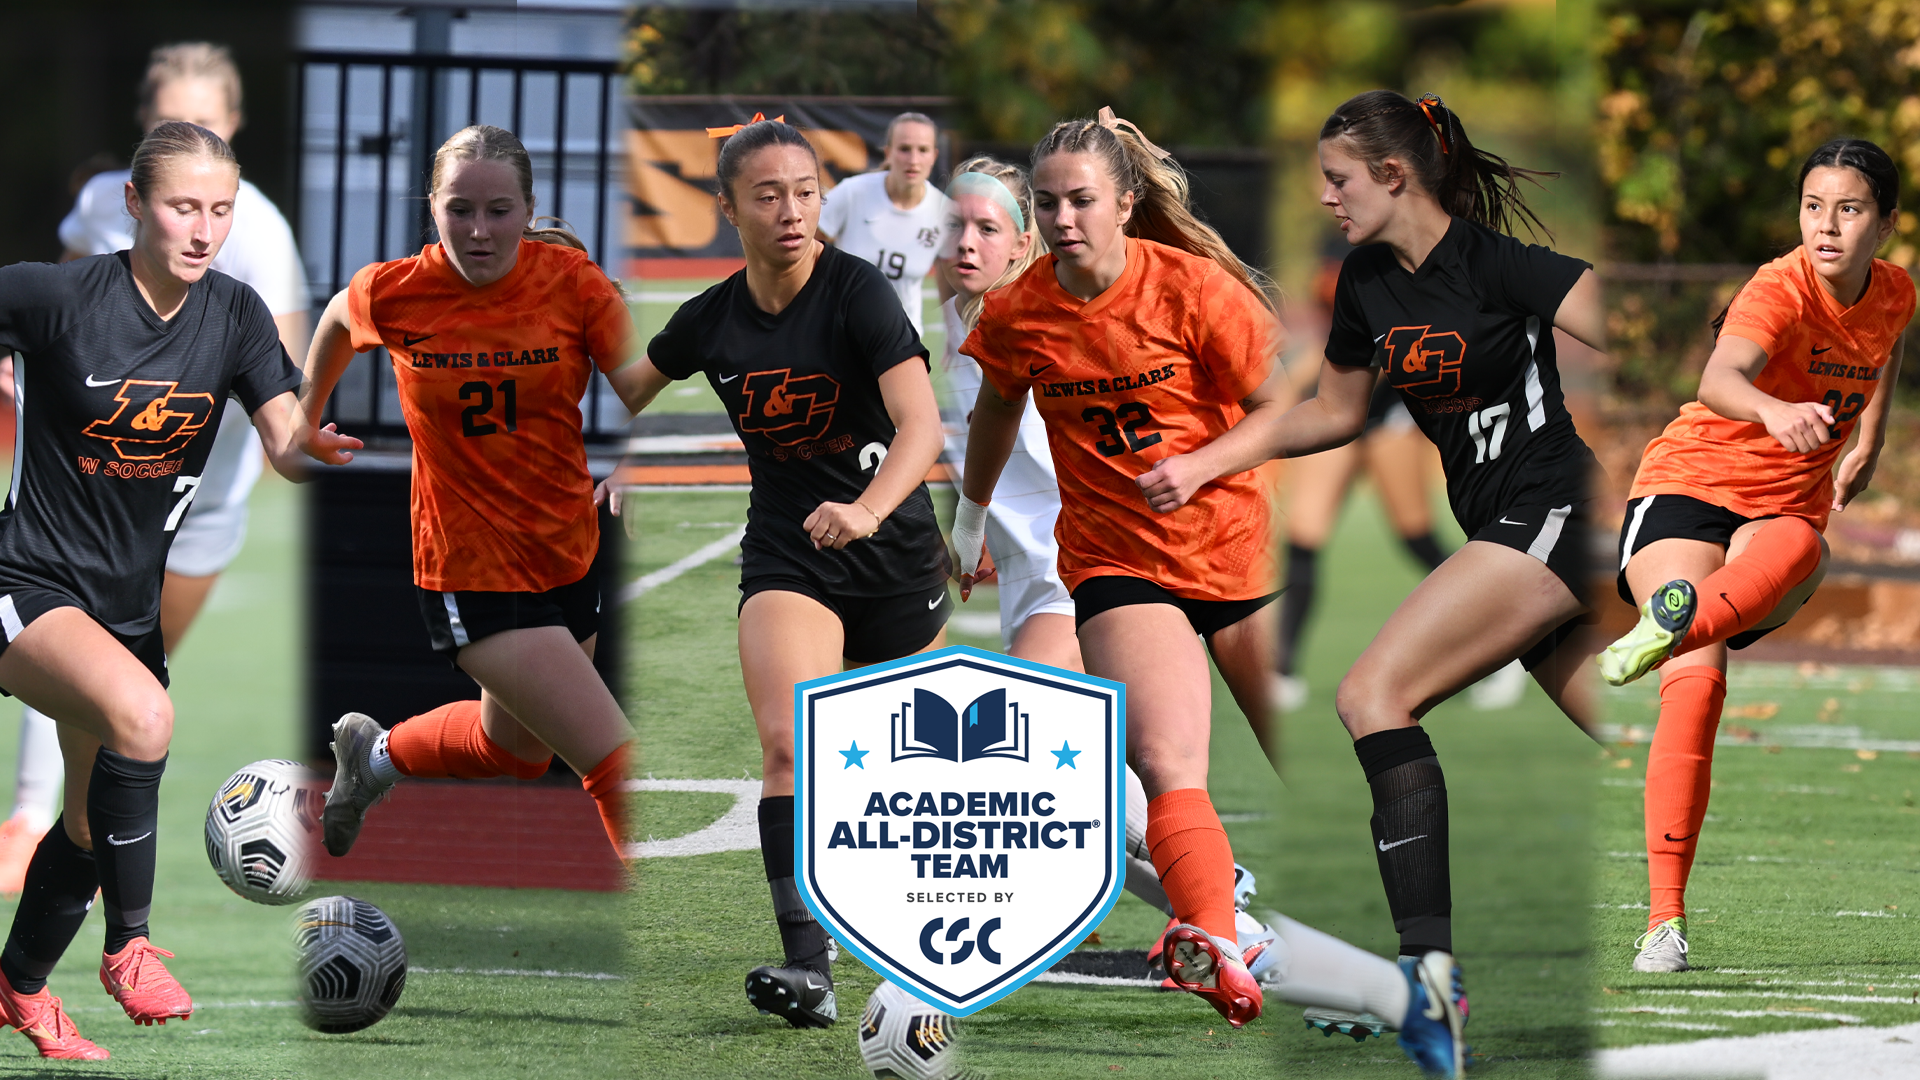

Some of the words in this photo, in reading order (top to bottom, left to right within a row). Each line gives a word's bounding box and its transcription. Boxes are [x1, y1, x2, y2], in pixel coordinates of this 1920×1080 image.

[877, 249, 906, 280] 19
[411, 352, 473, 369] LEWIS
[477, 352, 490, 367] &
[493, 347, 559, 367] CLARK
[1808, 361, 1848, 378] LEWIS
[1846, 366, 1857, 379] &
[1041, 380, 1096, 397] LEWIS
[1098, 379, 1111, 393] &
[1112, 364, 1176, 392] CLARK
[459, 379, 518, 437] 21
[1081, 402, 1163, 457] 32
[1468, 402, 1511, 464] 17
[77, 456, 100, 475] W
[163, 472, 204, 532] 7
